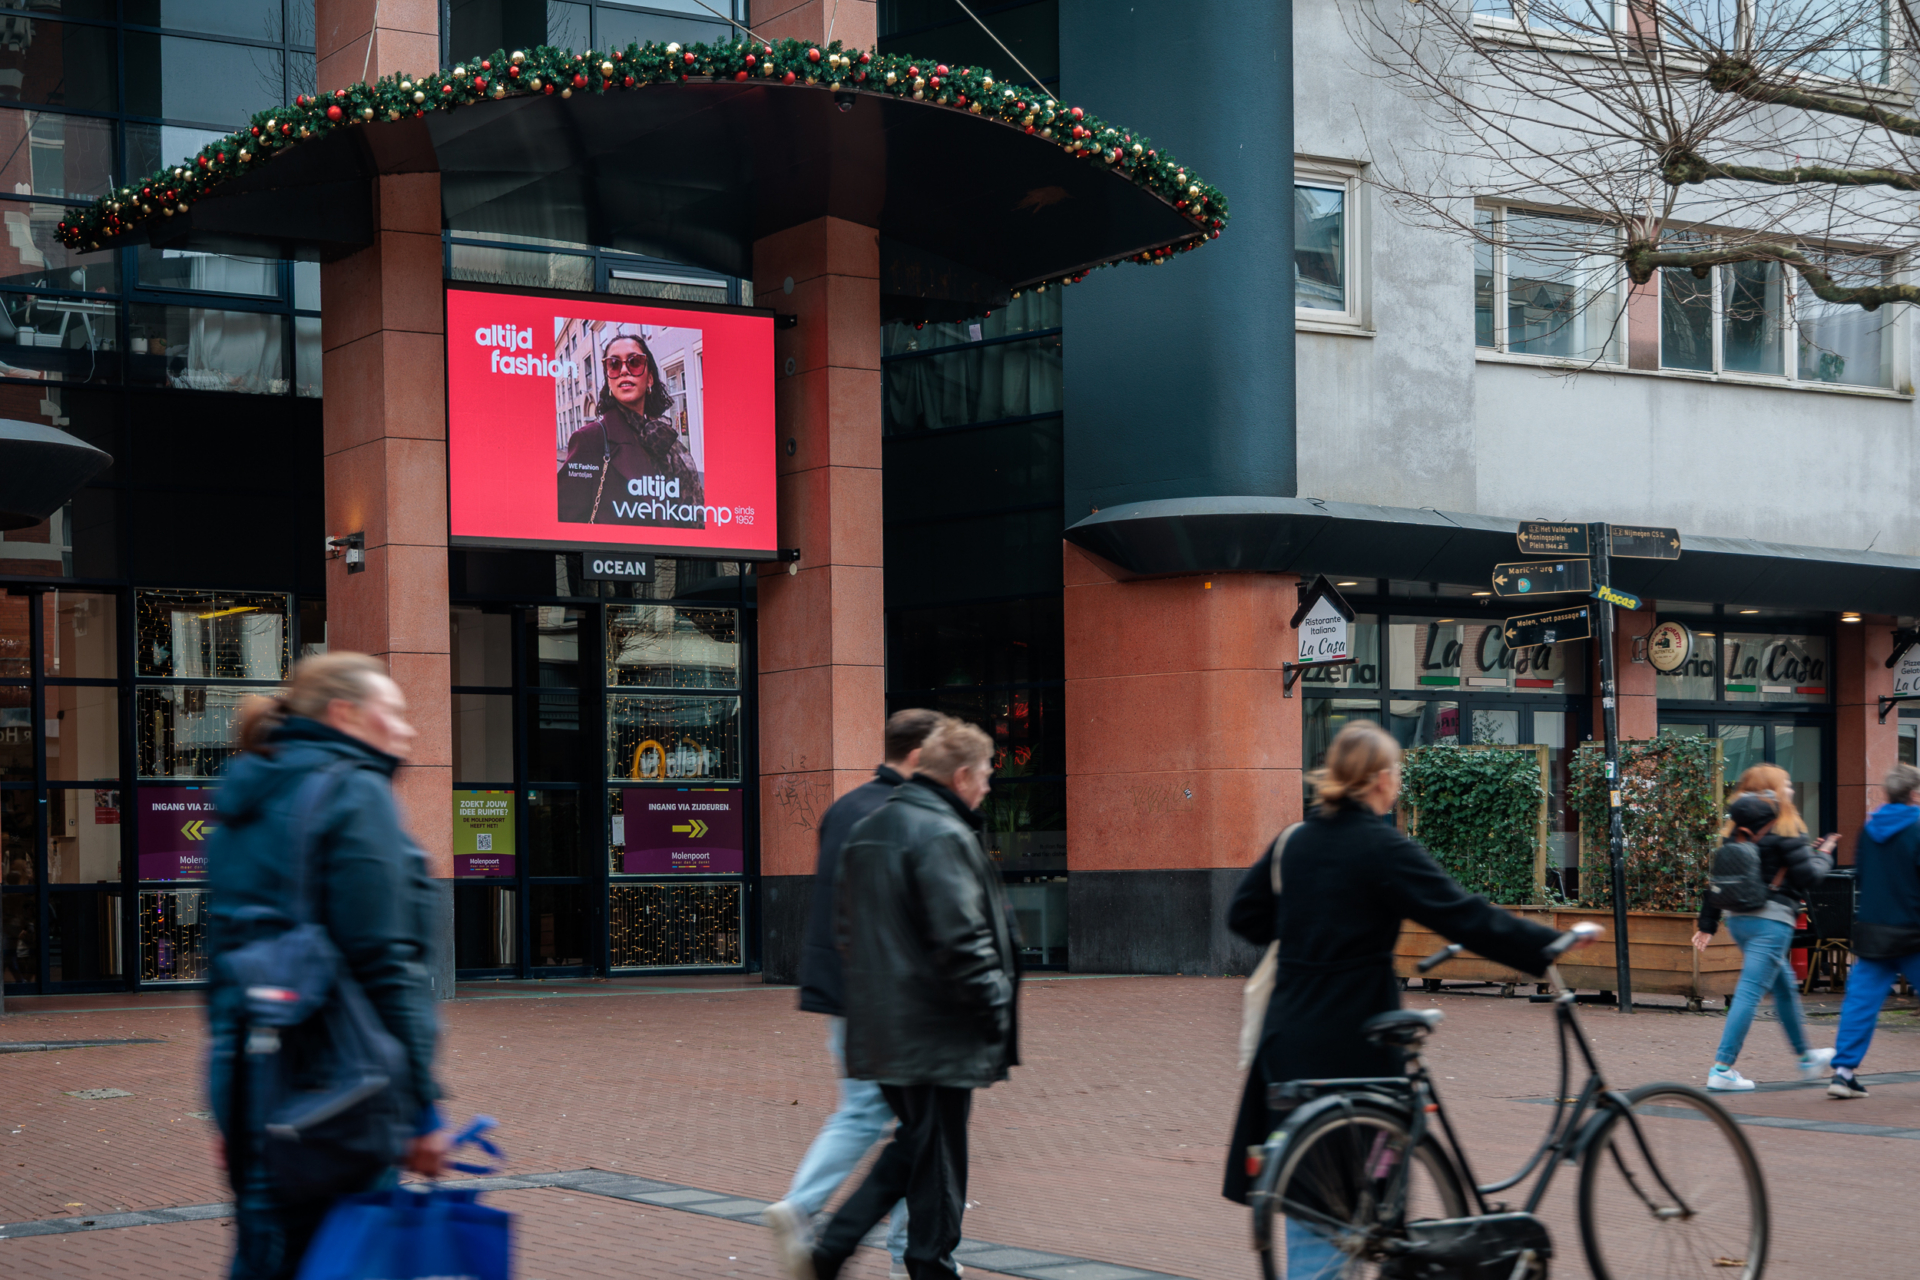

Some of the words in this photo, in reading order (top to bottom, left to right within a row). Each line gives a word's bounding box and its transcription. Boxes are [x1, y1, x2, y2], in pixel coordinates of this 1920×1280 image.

[475, 323, 532, 352] altijd
[491, 349, 578, 378] fashion
[578, 463, 600, 471] Fashion
[627, 475, 680, 500] altijd
[612, 499, 732, 526] wehkamp
[734, 506, 755, 515] sinds
[735, 515, 754, 525] 1952
[1529, 533, 1565, 542] Koningsplein
[1624, 529, 1650, 538] Nijmegen
[593, 560, 646, 576] OCEAN
[1598, 586, 1636, 608] Phocas
[1305, 615, 1341, 626] Ristorante
[1553, 612, 1579, 622] passage
[1310, 626, 1336, 635] Italiano
[1300, 640, 1314, 657] La
[1318, 637, 1346, 655] Casa
[1421, 622, 1463, 670] La
[1476, 624, 1552, 675] Casa
[1728, 642, 1758, 680] La
[1767, 644, 1825, 683] Casa
[1895, 678, 1909, 692] La
[152, 803, 185, 811] INGANG
[186, 803, 202, 811] VIA
[460, 800, 484, 808] ZOEKT
[485, 800, 508, 808] JOUW
[648, 803, 676, 811] INGANG
[677, 803, 690, 811] VIA
[459, 808, 476, 816] IDEE
[477, 808, 508, 816] RUIMTE?
[179, 855, 210, 866] Molenp
[671, 851, 710, 861] Molenpoort
